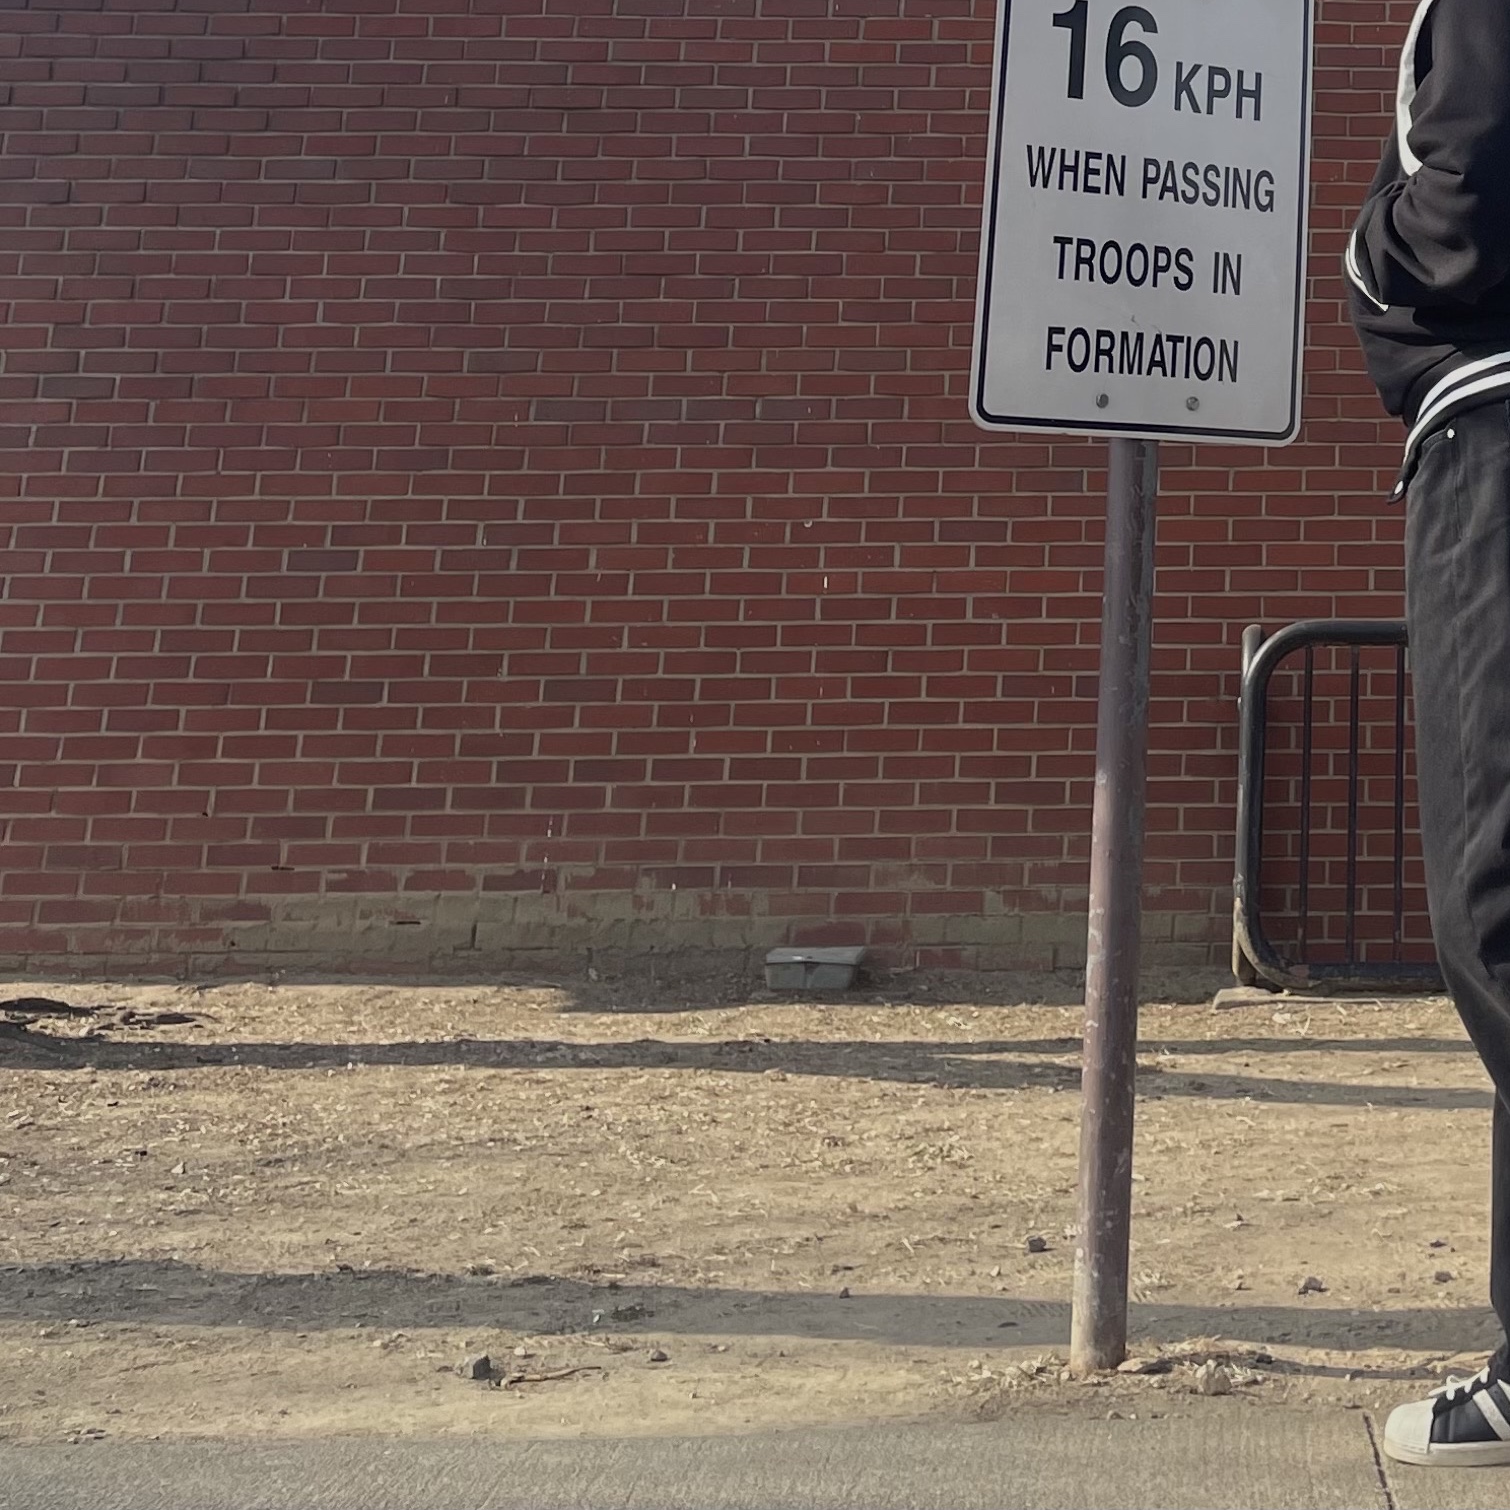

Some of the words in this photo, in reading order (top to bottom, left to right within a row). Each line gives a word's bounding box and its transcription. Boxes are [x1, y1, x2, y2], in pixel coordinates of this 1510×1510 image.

[1052, 0, 1158, 108] 16
[1173, 61, 1262, 121] KPH
[1026, 144, 1126, 197] WHEN
[1141, 157, 1275, 213] PASSING
[1052, 236, 1194, 291] TROOPS
[1212, 251, 1242, 296] IN
[1045, 326, 1240, 384] FORMATION
